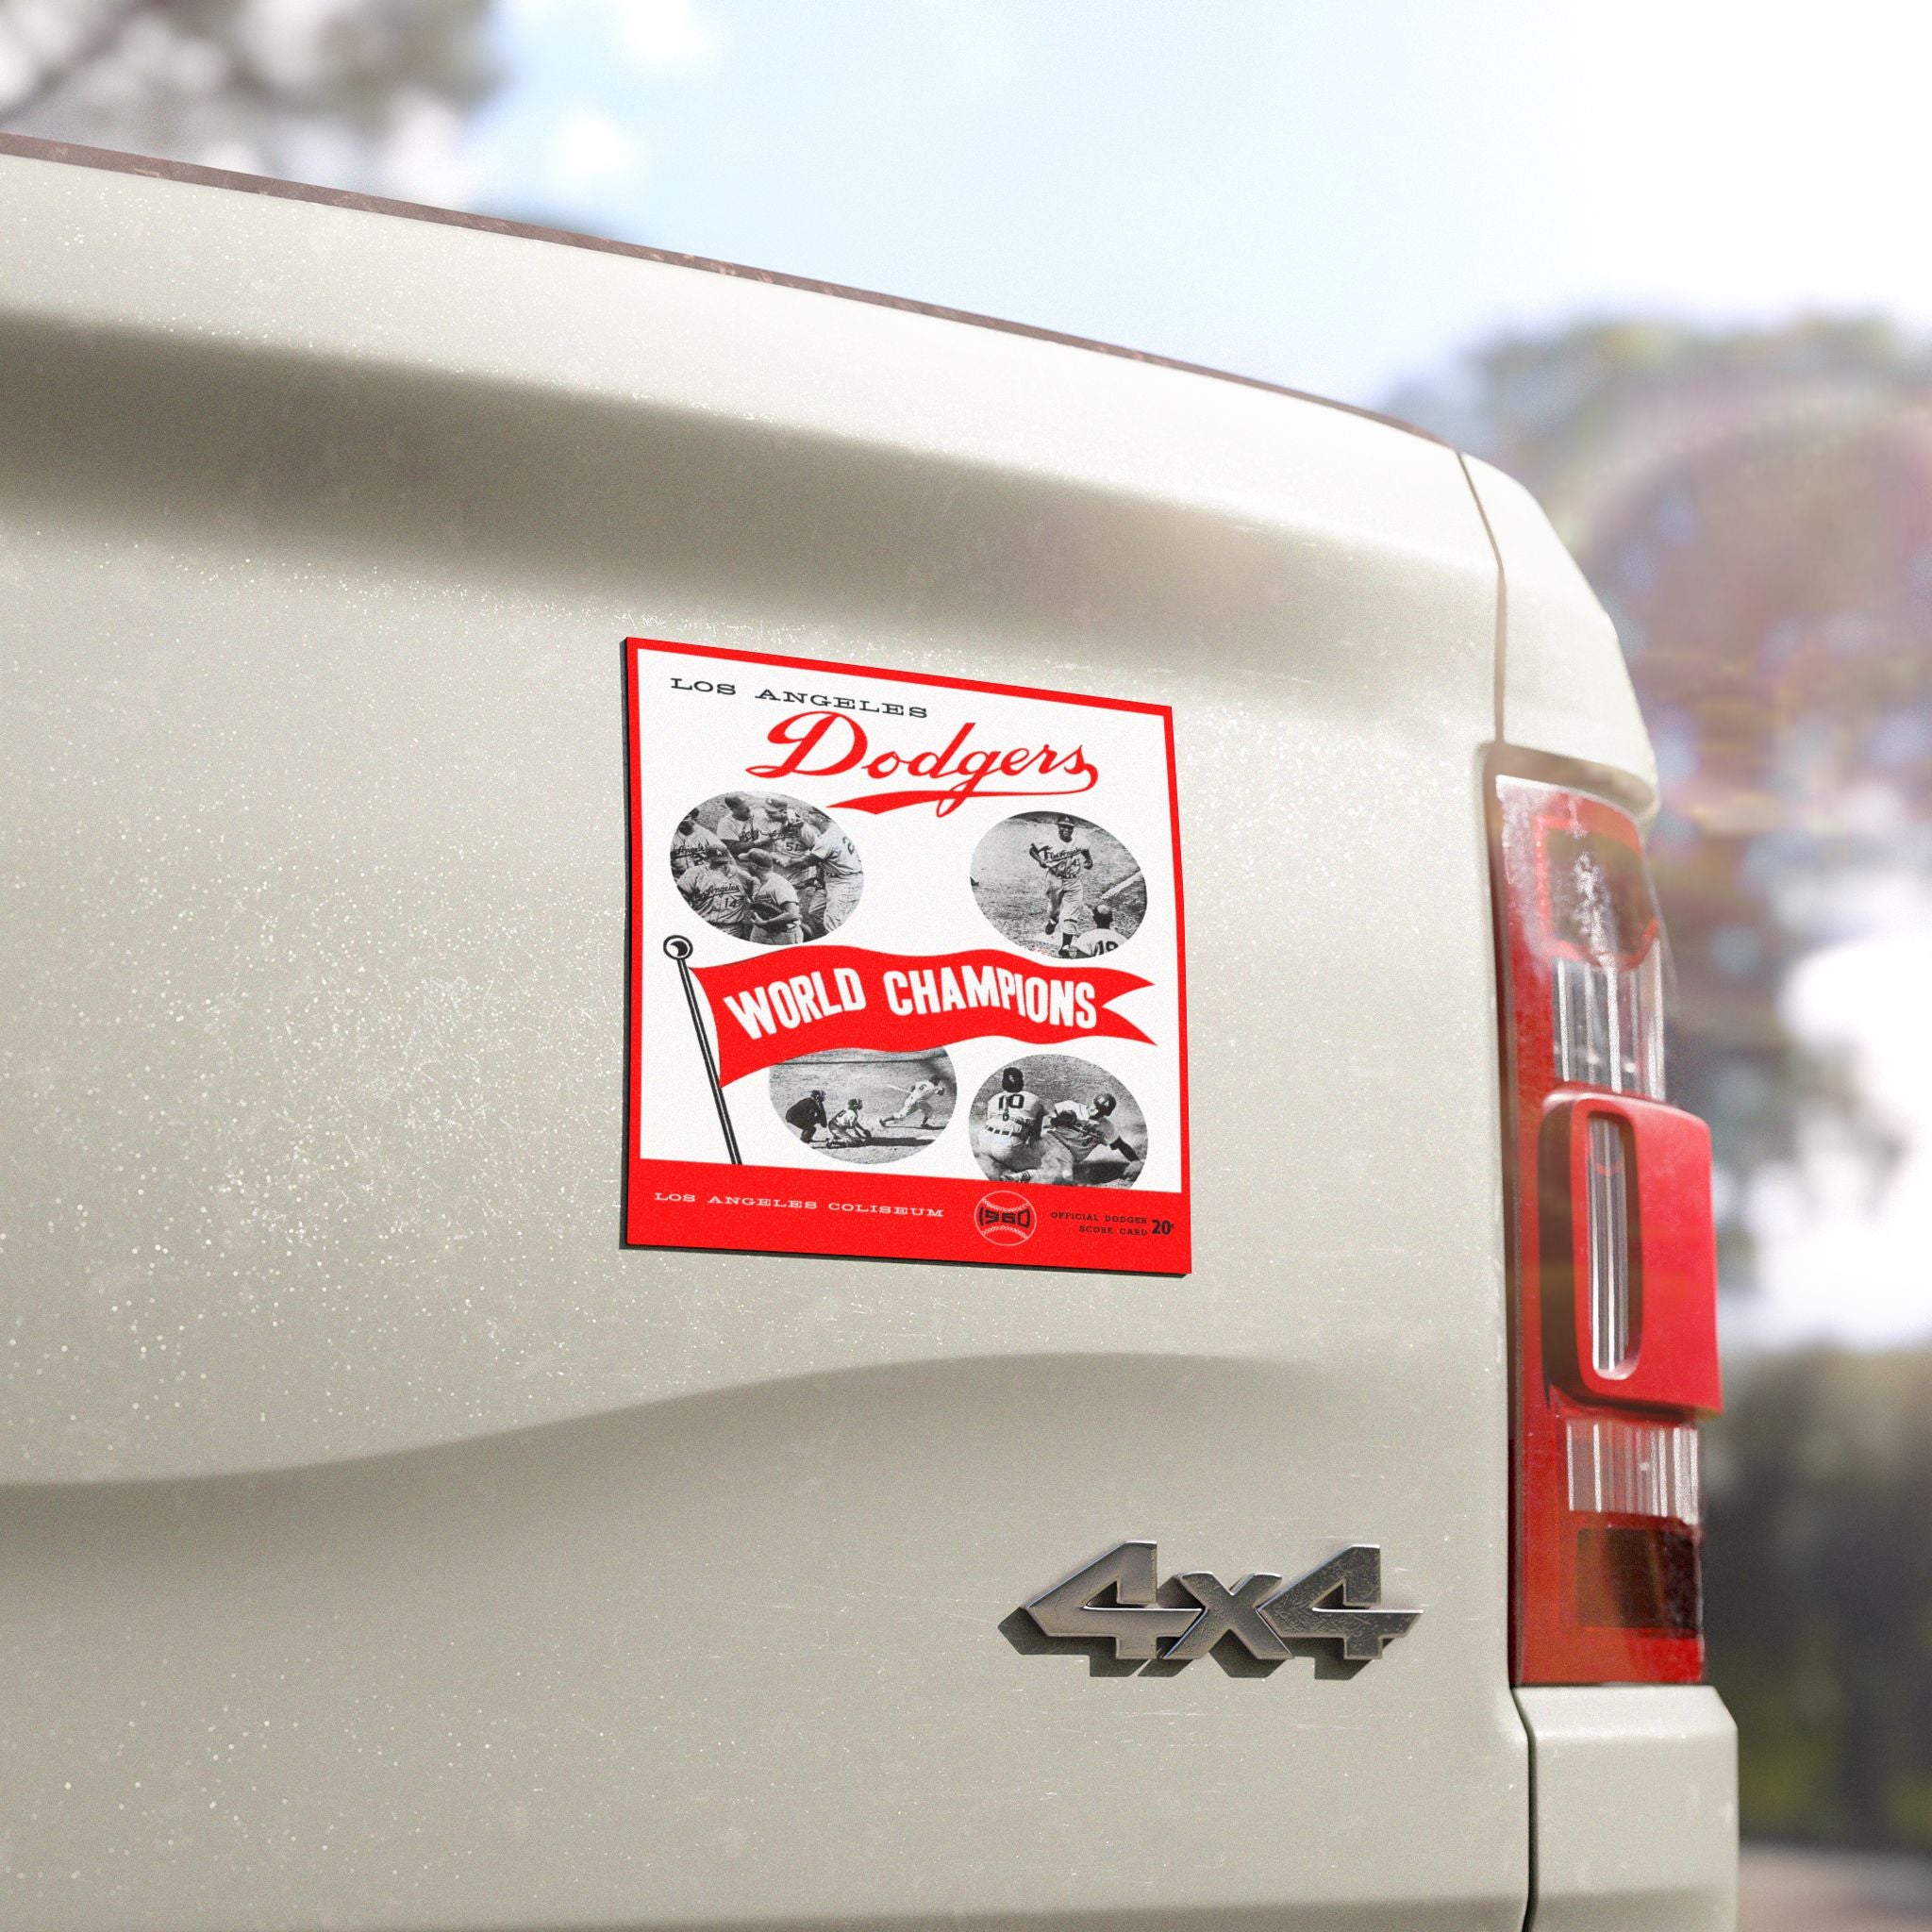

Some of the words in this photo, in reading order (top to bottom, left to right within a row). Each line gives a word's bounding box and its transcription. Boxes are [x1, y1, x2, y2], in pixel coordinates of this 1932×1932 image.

[669, 677, 737, 696] LOS
[755, 689, 927, 719] ANGELES
[745, 711, 1099, 818] Dodgers
[724, 967, 867, 1041] WORLD
[883, 965, 1098, 1029] CHAMPIONS
[655, 1192, 696, 1203] LOS
[707, 1195, 818, 1210] ANGELES
[828, 1202, 944, 1218] COLISEUM
[978, 1207, 1032, 1229] 1960
[1050, 1210, 1100, 1222] OFFICIAL
[1105, 1214, 1148, 1224] DODGER
[1078, 1224, 1114, 1235] SCORE
[1119, 1226, 1148, 1237] CARD
[1024, 1541, 1424, 1660] 4x4
